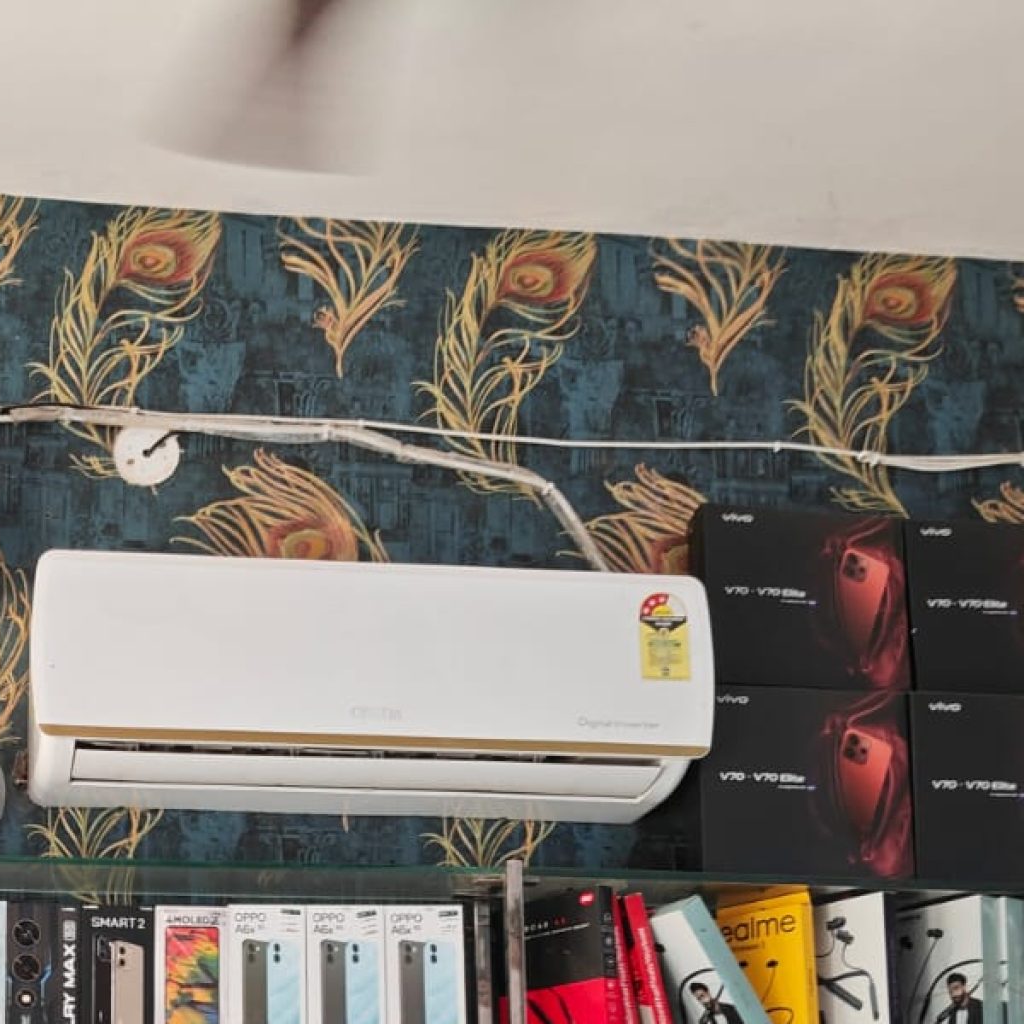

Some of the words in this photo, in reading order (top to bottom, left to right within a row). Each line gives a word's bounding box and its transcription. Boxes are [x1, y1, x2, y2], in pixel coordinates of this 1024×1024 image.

[722, 513, 754, 523] vivo
[920, 527, 953, 537] vivo
[725, 586, 749, 596] V70
[758, 587, 782, 597] V70
[927, 599, 950, 609] V70
[959, 599, 983, 609] V70
[716, 695, 749, 704] vivo
[928, 702, 961, 712] vivo
[720, 772, 745, 782] V70
[754, 773, 778, 783] V70
[779, 773, 806, 784] Elite
[932, 780, 956, 790] V70
[966, 780, 990, 790] V70
[991, 781, 1017, 791] Elite
[91, 916, 136, 929] SMART
[138, 917, 146, 930] 2
[721, 914, 796, 944] ealme
[63, 944, 76, 989] MAX
